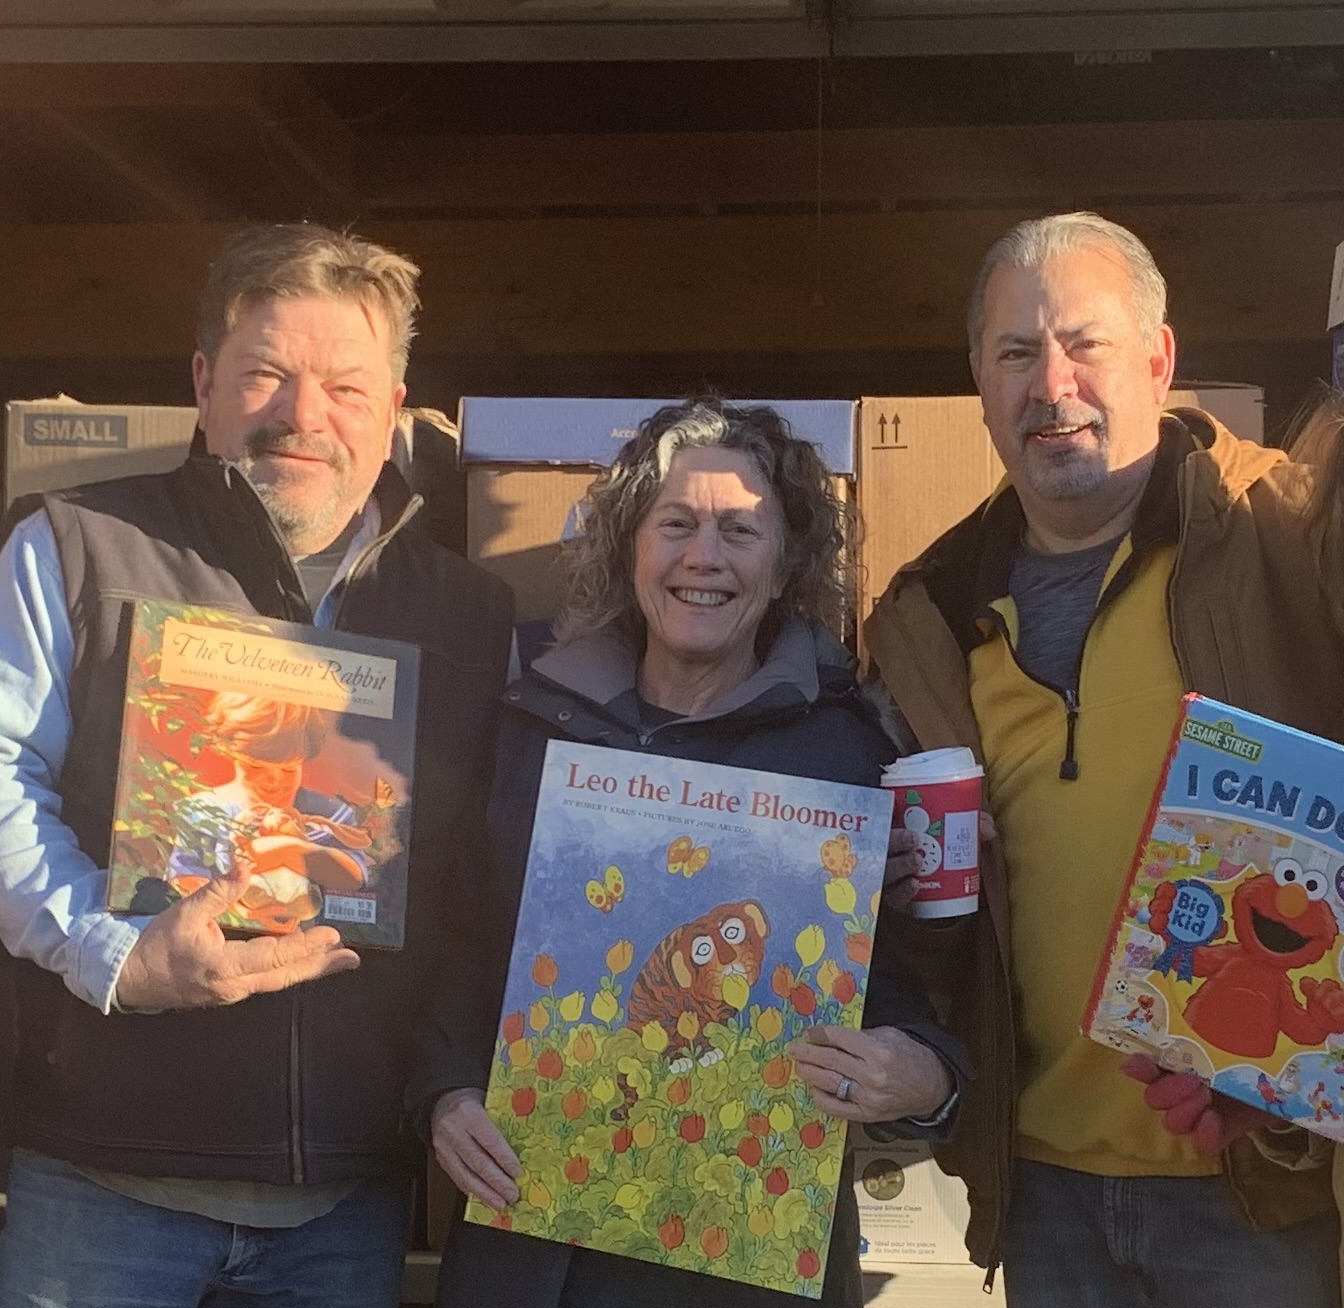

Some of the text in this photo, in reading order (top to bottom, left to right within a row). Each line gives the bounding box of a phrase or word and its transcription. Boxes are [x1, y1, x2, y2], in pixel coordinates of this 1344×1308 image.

[32, 419, 118, 441] SMALL
[174, 633, 387, 693] The Velveteen Rabbit
[1185, 722, 1260, 759] SESAME STREET
[567, 763, 869, 832] Leo the Late Bloomer
[1188, 765, 1198, 797] I
[1212, 769, 1301, 818] CAN
[1172, 909, 1206, 937] Kid
[1177, 891, 1209, 918] Big
